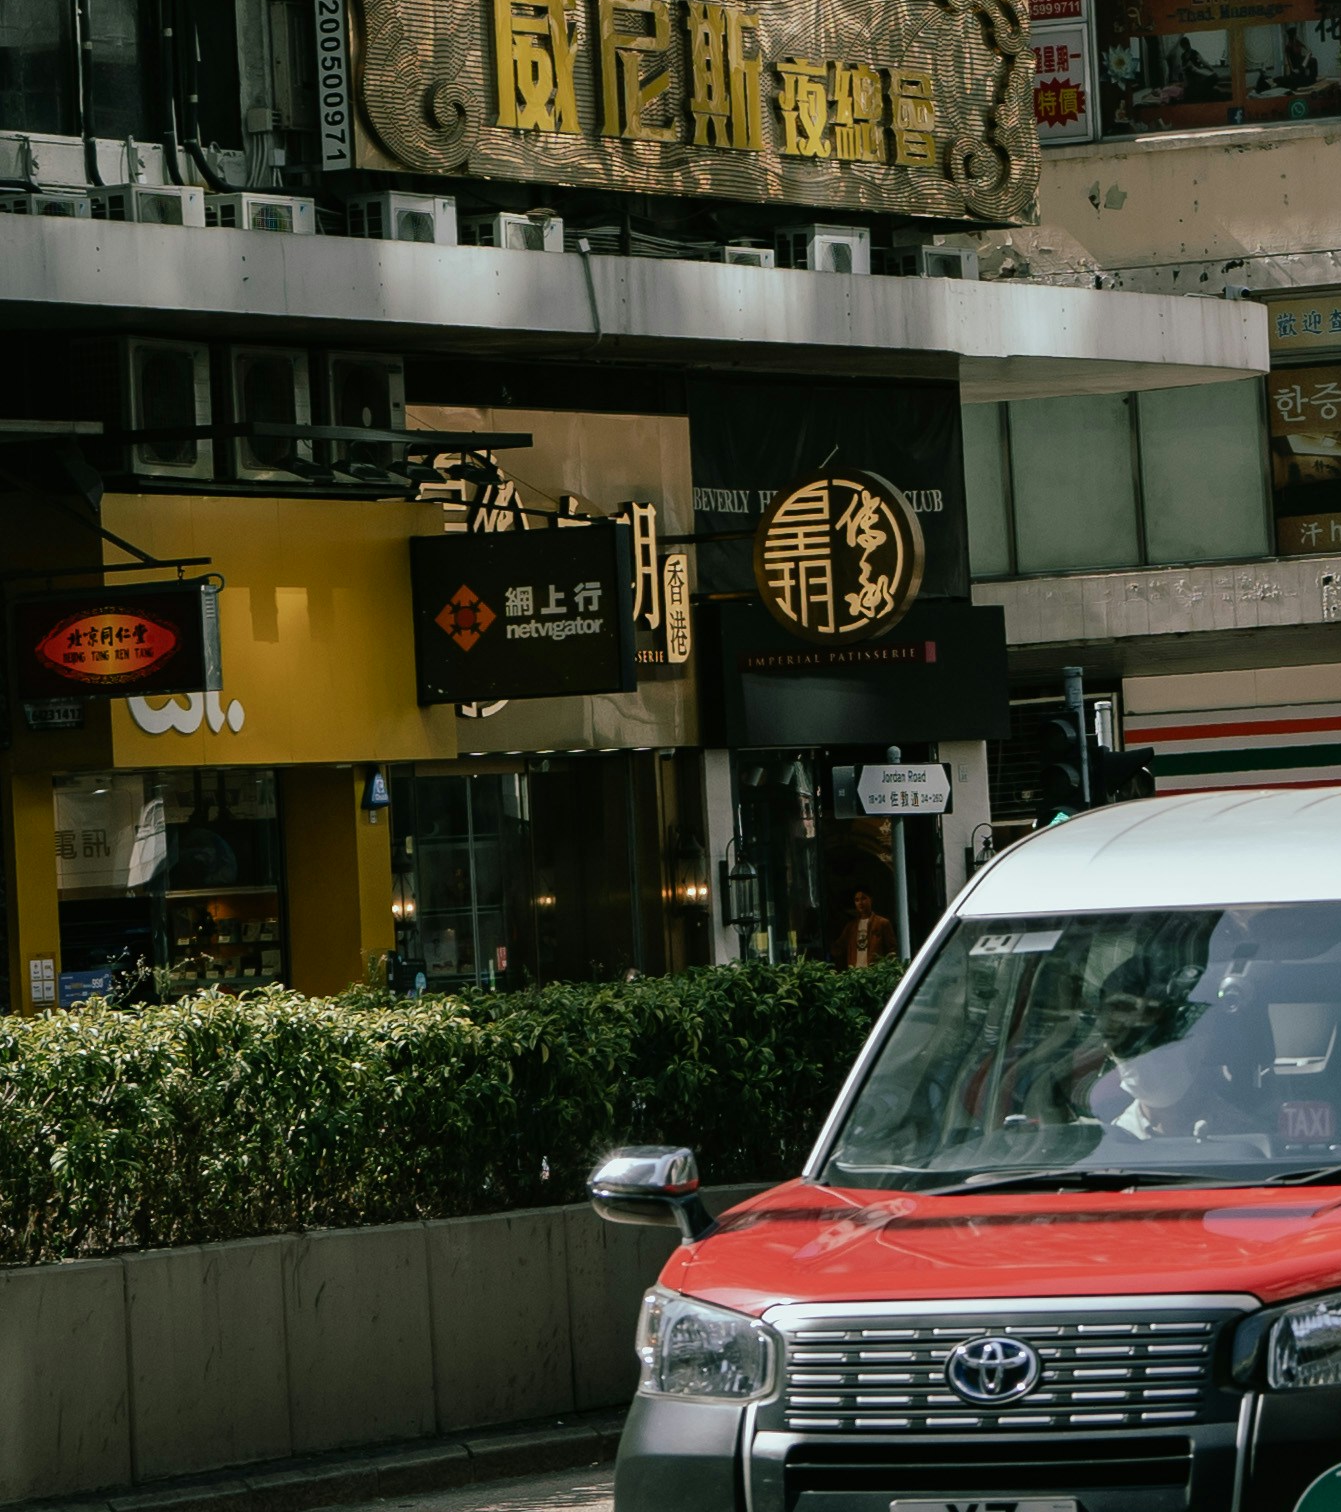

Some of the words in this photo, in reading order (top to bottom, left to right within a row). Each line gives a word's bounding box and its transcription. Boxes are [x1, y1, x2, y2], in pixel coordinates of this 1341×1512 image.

[1038, 89, 1080, 117] 特價
[694, 487, 750, 514] BEVERLY
[505, 581, 603, 617] 網上行
[667, 559, 688, 656] 香港
[506, 616, 604, 641] netvigator
[748, 653, 820, 667] IMPERIAL
[829, 647, 916, 663] PATISSERIE
[908, 770, 927, 783] Road
[1283, 1108, 1332, 1139] TAXI
